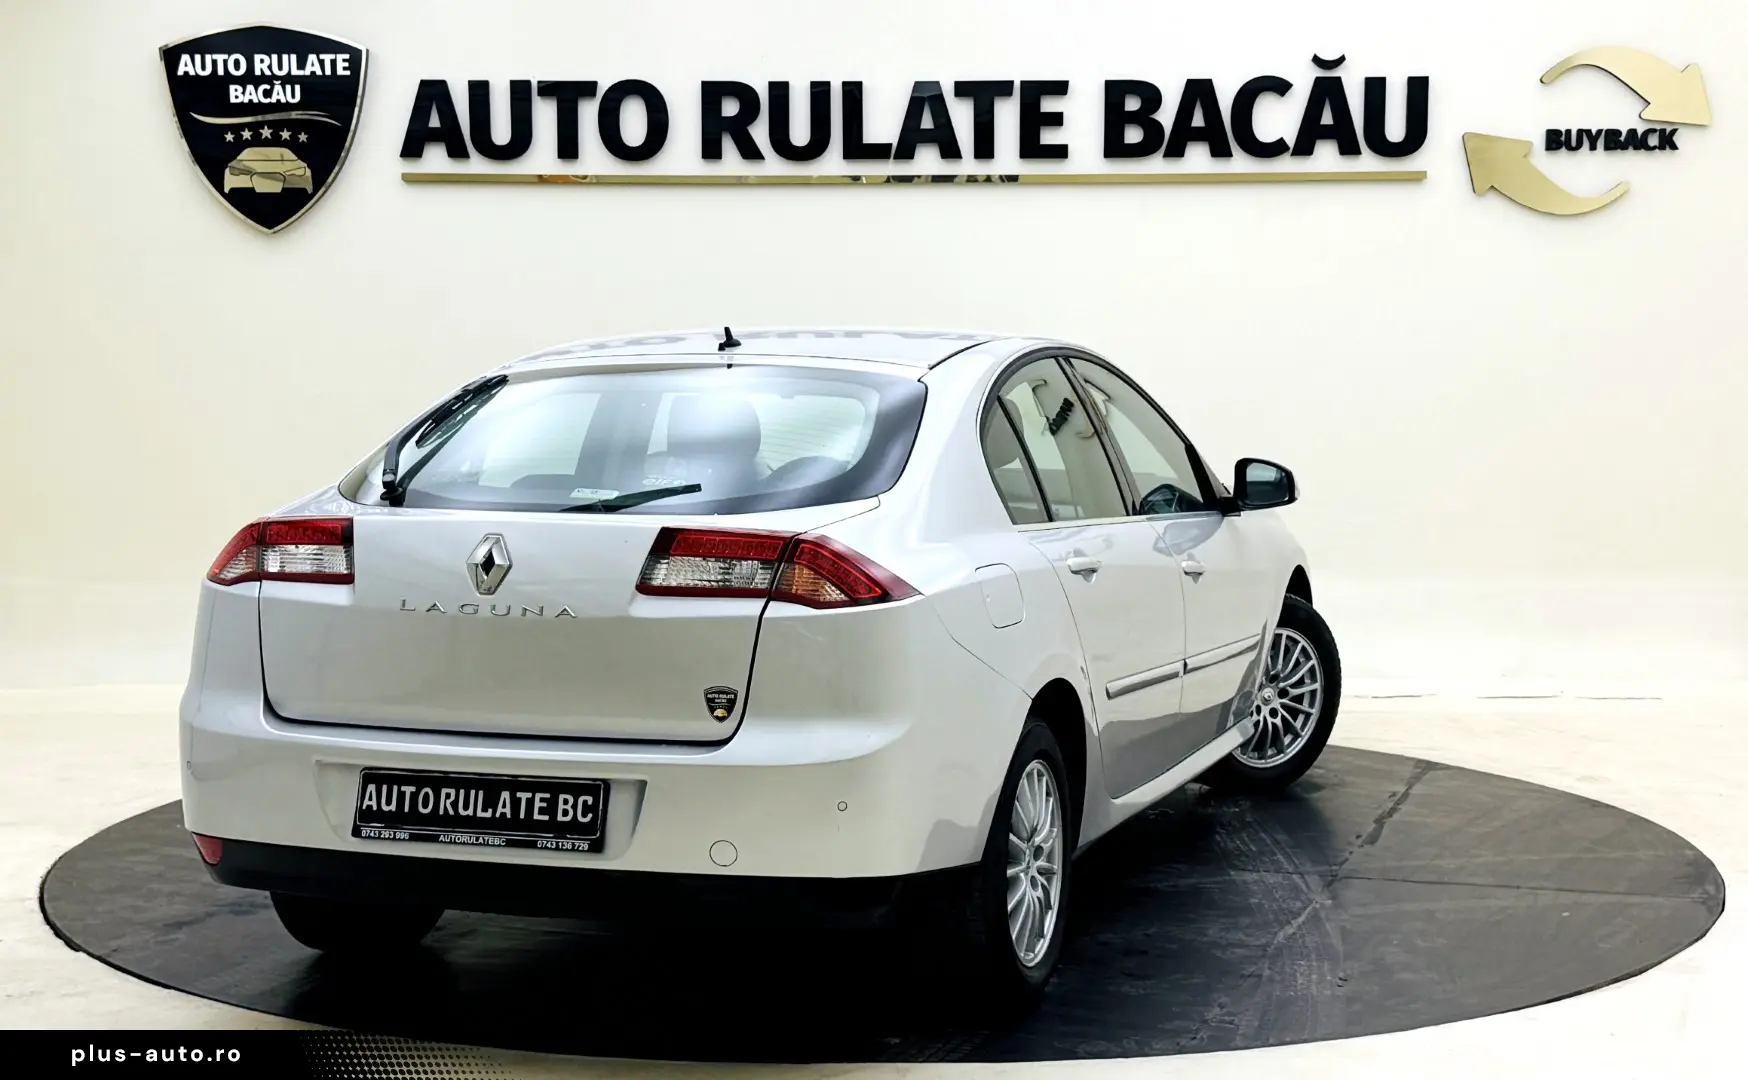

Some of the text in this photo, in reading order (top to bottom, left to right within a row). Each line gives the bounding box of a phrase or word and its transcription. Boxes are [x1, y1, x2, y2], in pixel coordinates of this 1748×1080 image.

[177, 53, 350, 76] AUTO RULATE
[229, 80, 301, 104] BACĂU
[400, 54, 1430, 163] AUTO RULATE BACĂU
[1545, 128, 1679, 152] BUYBACK
[400, 598, 577, 618] LAGUNA
[362, 783, 593, 823] AUTO RULATE BC
[361, 830, 379, 838] 0743
[380, 831, 394, 839] 293
[439, 834, 506, 846] AUTORULATEBC
[537, 841, 589, 851] 0743 136 729
